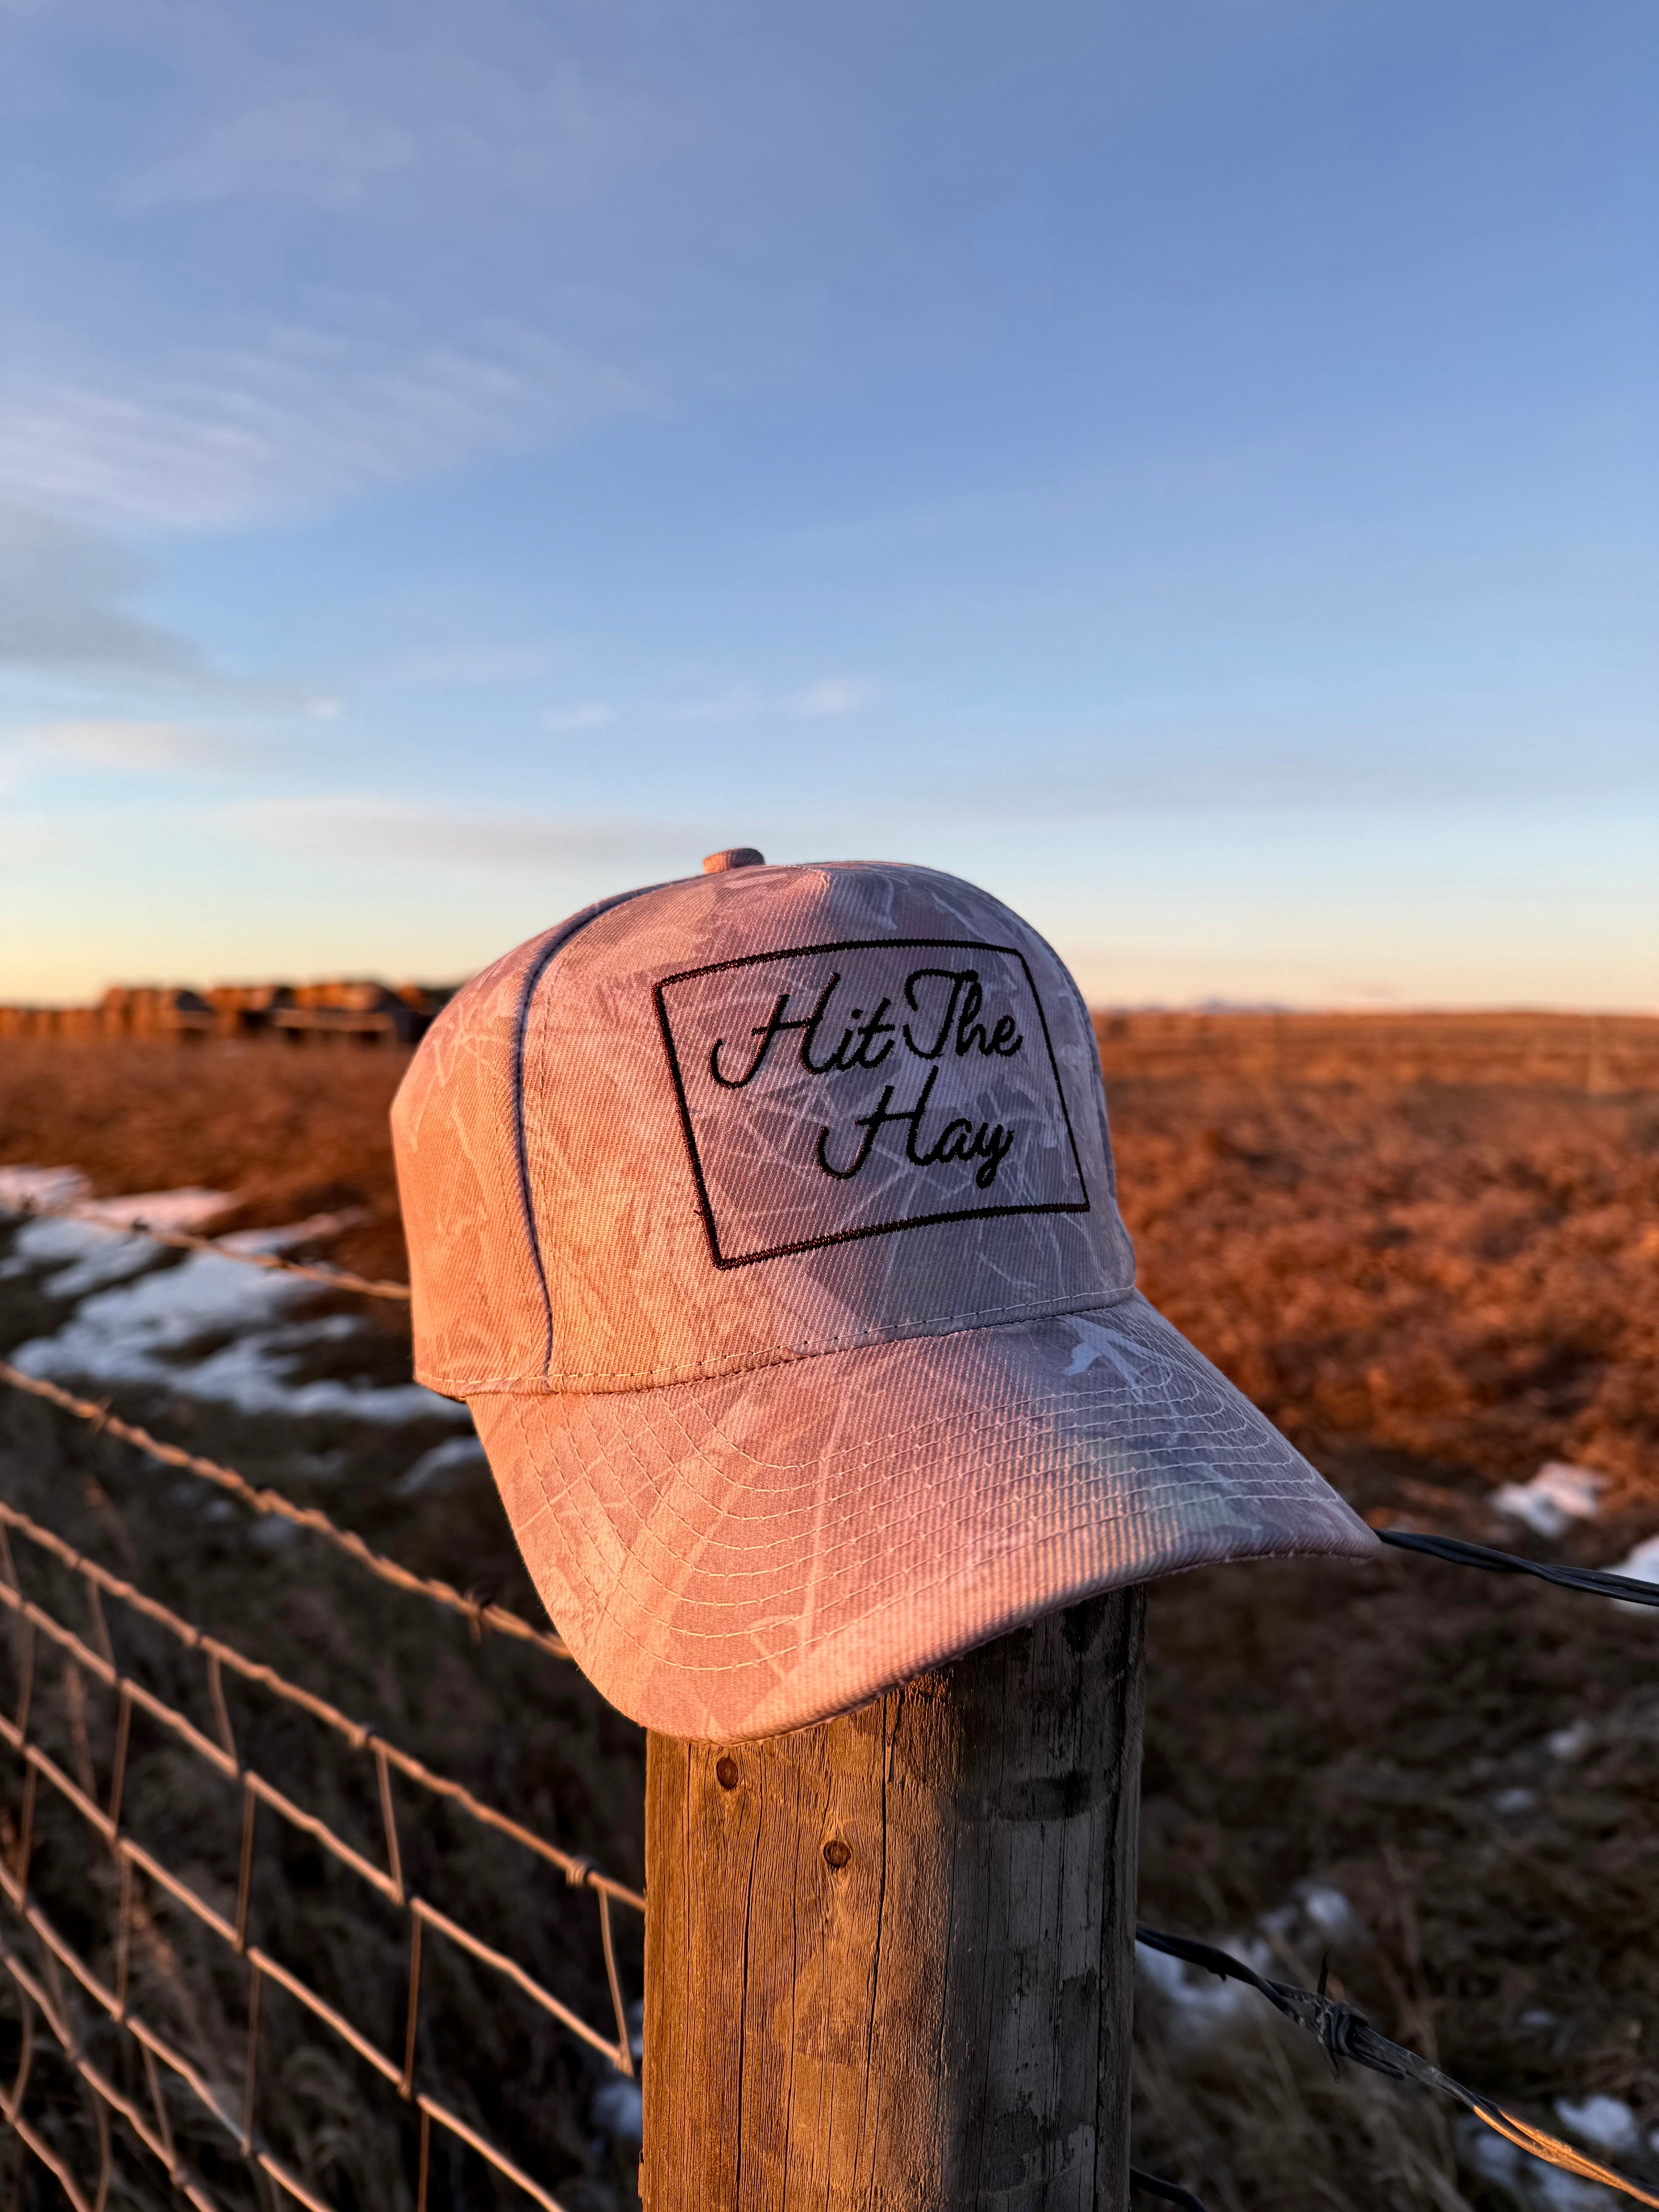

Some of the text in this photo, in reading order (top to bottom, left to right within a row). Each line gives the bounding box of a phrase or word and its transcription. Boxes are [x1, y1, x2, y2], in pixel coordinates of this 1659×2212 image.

[709, 969, 1023, 1090] Hit The
[815, 1065, 1014, 1190] Hay
